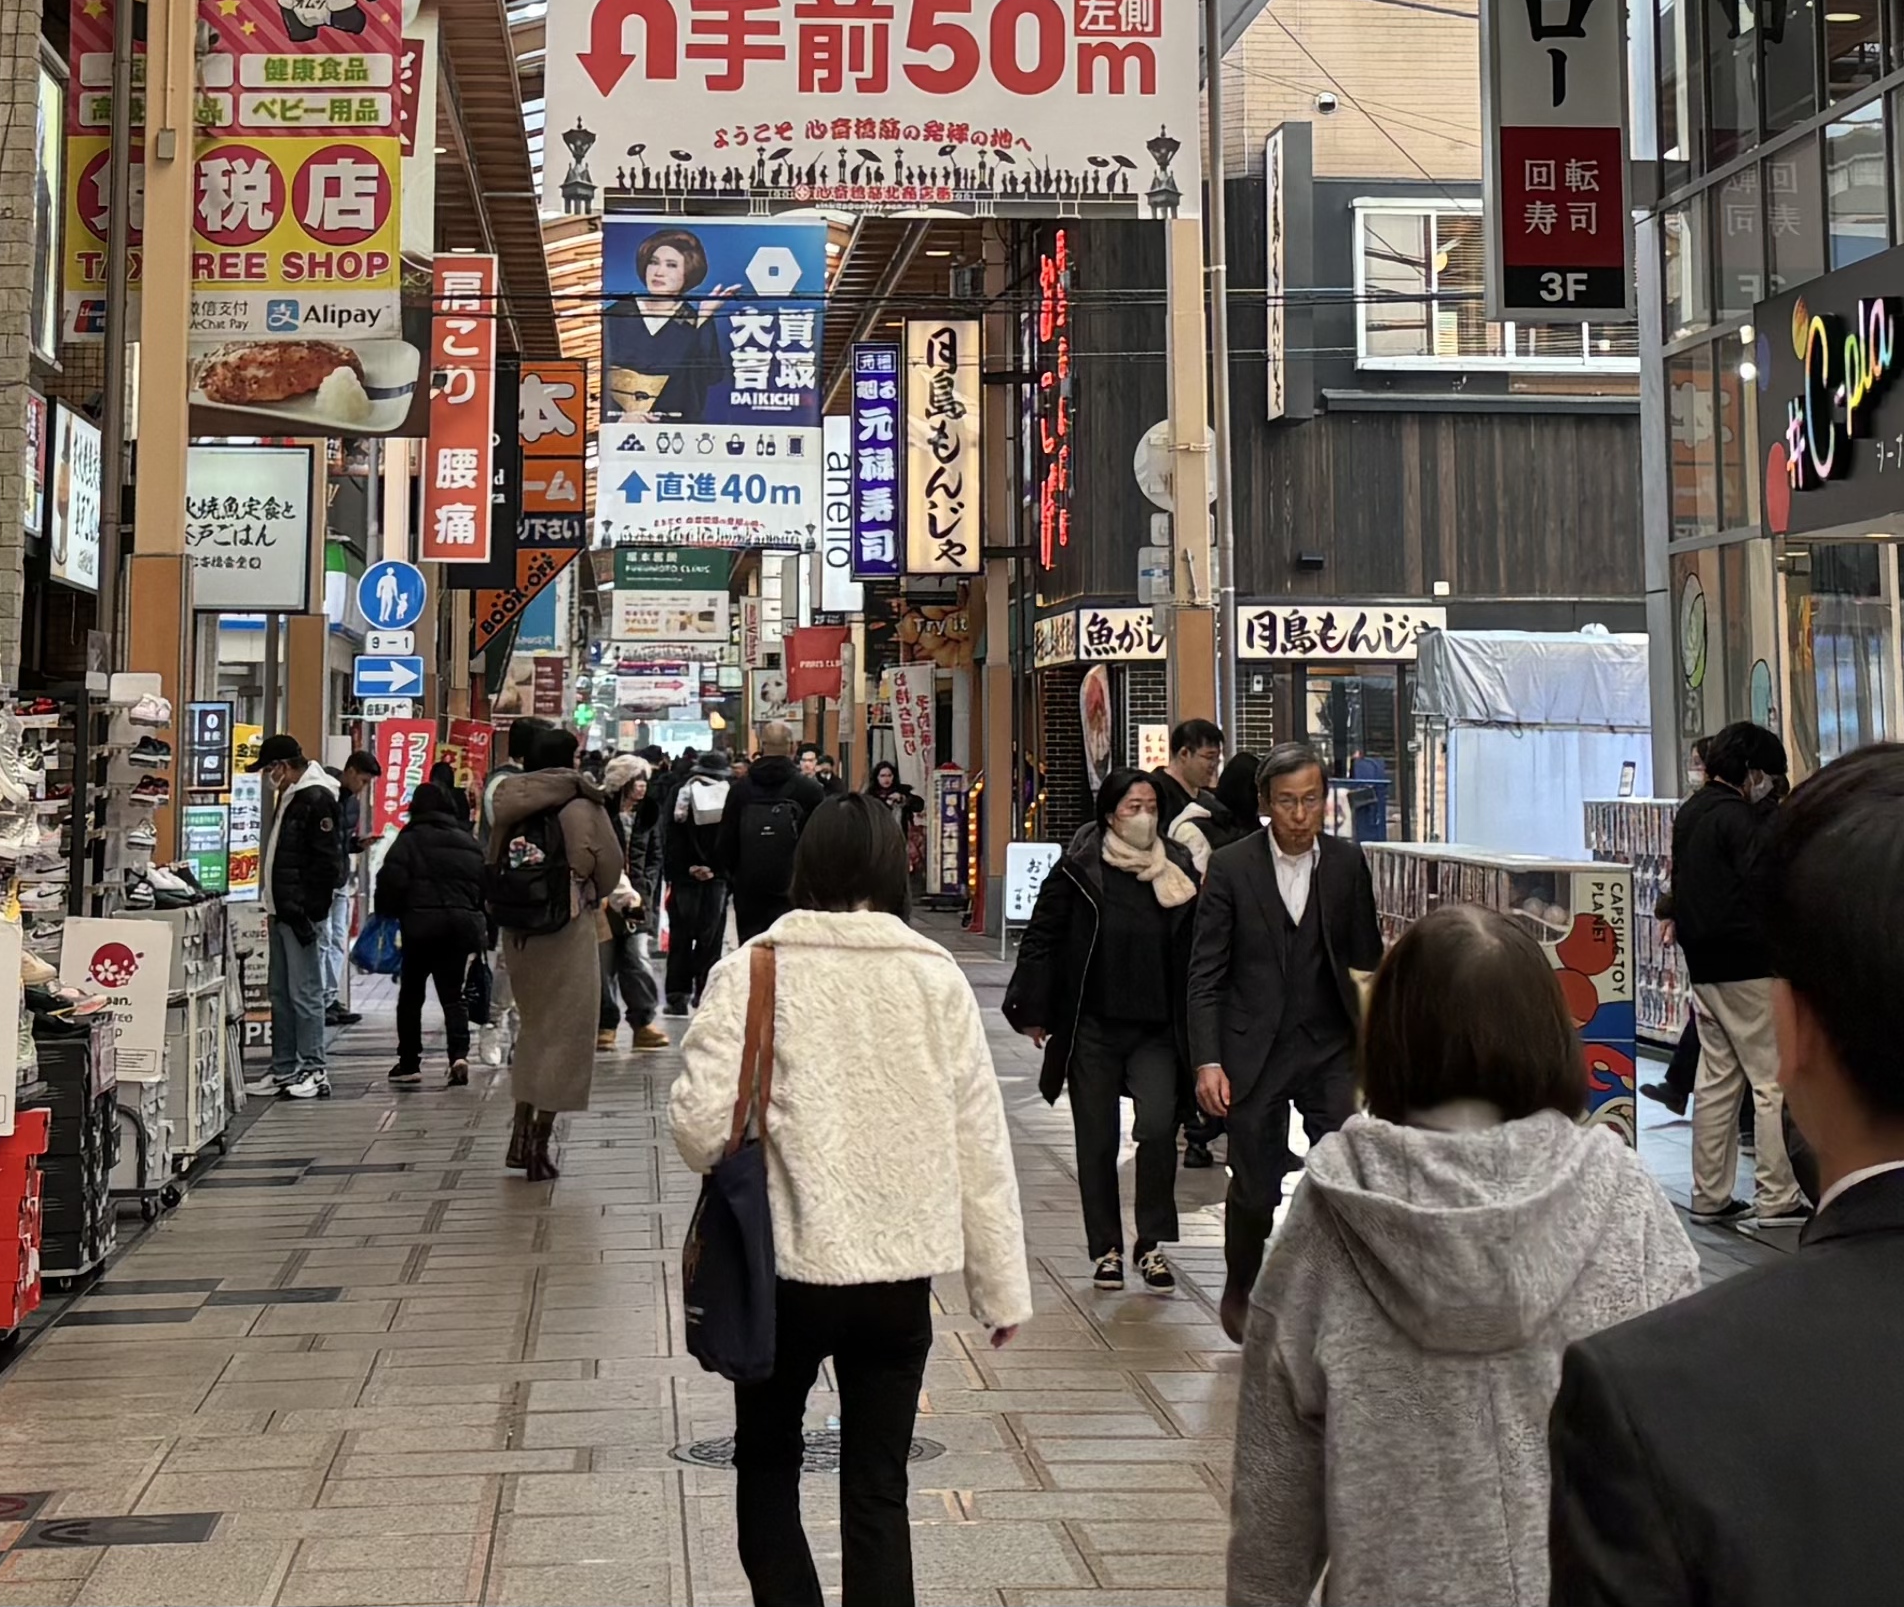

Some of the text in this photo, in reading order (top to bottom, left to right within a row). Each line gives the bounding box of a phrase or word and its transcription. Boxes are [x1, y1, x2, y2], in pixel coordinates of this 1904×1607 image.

[263, 57, 369, 83] 健康食品
[251, 98, 380, 123] ベビー用品
[713, 121, 794, 149] ようこそ
[1522, 157, 1600, 194] 回転
[1522, 198, 1600, 236] 寿司
[281, 250, 391, 282] SHOP
[1538, 271, 1589, 303] 3F
[303, 305, 382, 329] Alipay
[728, 305, 776, 391] 大吉
[774, 306, 817, 390] 買取
[432, 270, 483, 546] 肩こり 腰痛
[730, 391, 800, 406] DAIKICHI
[925, 326, 967, 568] 月島もんじゃ
[655, 470, 802, 505] 直進40m
[858, 406, 896, 564] 元禄寿司
[825, 451, 852, 569] anello
[1084, 611, 1167, 658] 魚がし
